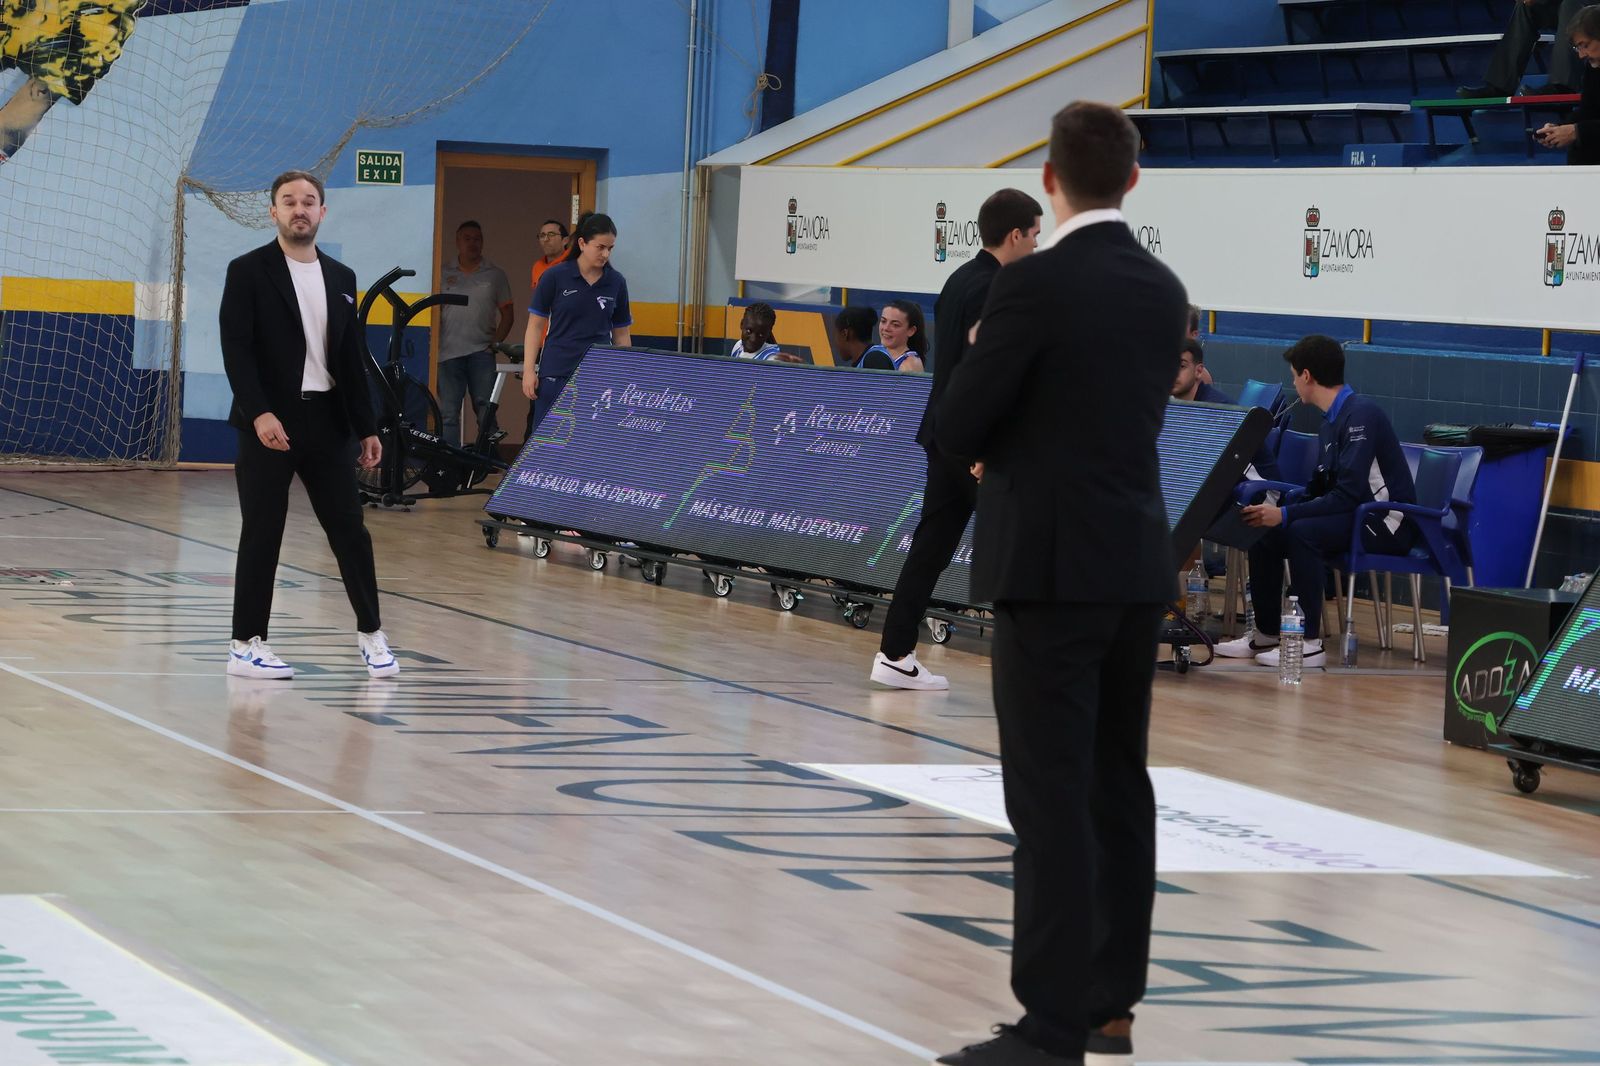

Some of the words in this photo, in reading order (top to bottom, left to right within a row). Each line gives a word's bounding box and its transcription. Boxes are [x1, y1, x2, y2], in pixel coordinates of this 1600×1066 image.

[359, 154, 400, 166] SALIDA
[363, 169, 397, 180] EXIT
[797, 215, 830, 240] ZAMORA
[947, 220, 982, 246] ZAMOR
[1131, 225, 1162, 254] ORA
[1321, 228, 1374, 259] ZAMORA
[1566, 232, 1600, 265] ZAM
[617, 383, 697, 413] Recoletas
[617, 409, 667, 433] Zamora
[804, 404, 896, 436] Recoletas
[804, 432, 862, 458] Zamora
[516, 468, 542, 486] MÁS
[581, 480, 609, 500] MÁS
[608, 486, 668, 510] DEPORTE
[688, 498, 720, 520] MÁS
[766, 510, 798, 533] MÁS
[799, 517, 870, 544] DEPORTE
